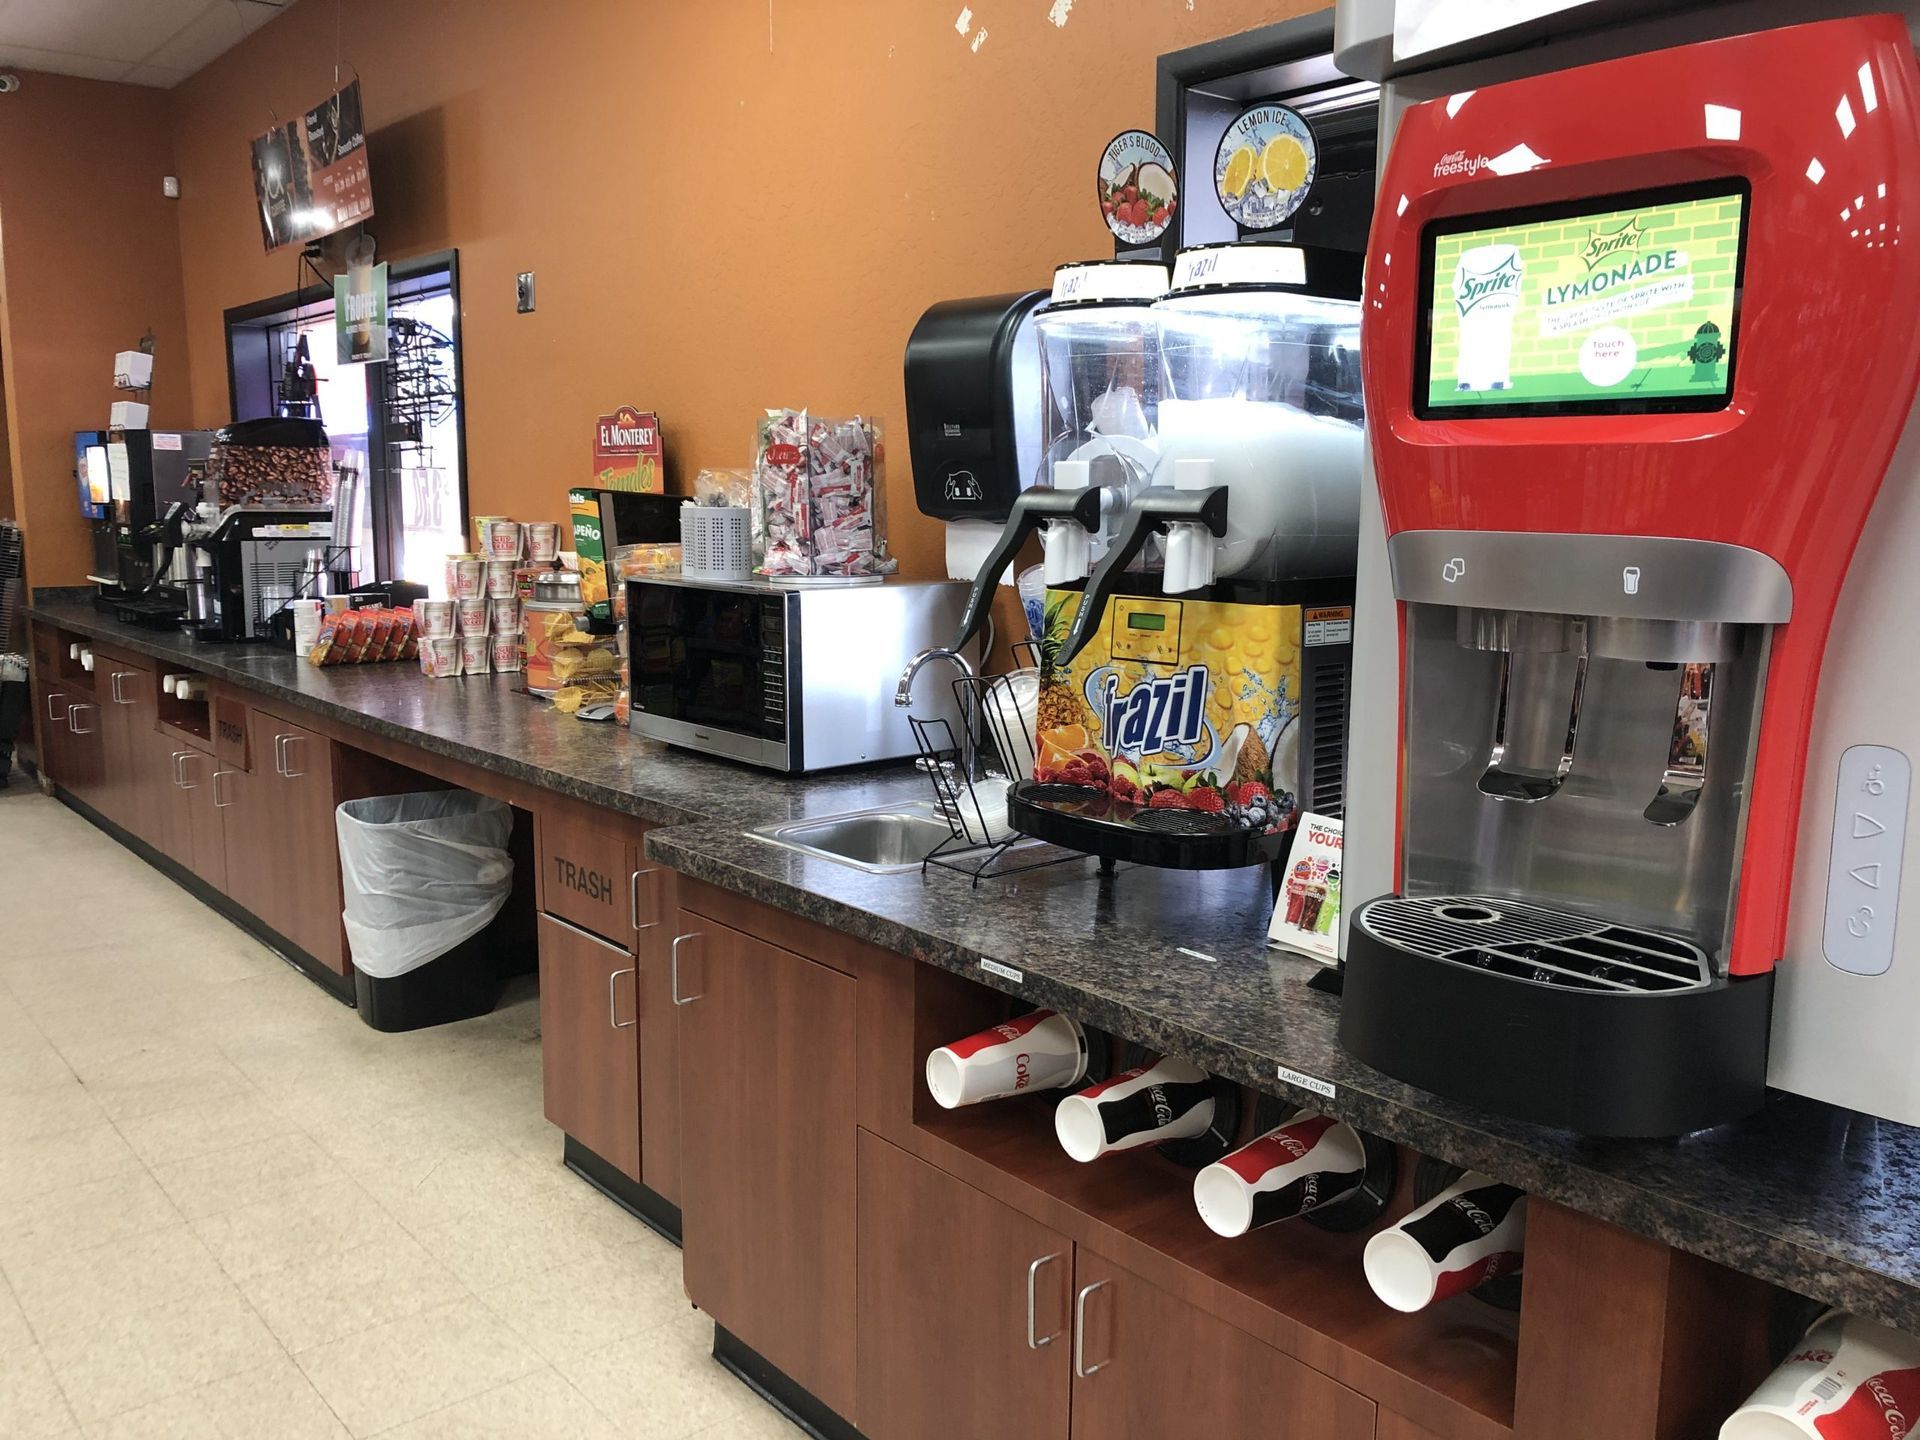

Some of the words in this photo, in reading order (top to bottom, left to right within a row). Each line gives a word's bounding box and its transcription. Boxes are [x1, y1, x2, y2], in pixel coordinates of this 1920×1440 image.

[1237, 110, 1269, 135] LEMON
[1272, 110, 1288, 127] ICE
[1109, 135, 1134, 158] TIGER'S
[1136, 136, 1161, 158] BLOOD
[1433, 154, 1489, 178] freestyle
[1586, 232, 1637, 257] Sprite
[1460, 271, 1515, 300] Sprite
[1547, 250, 1677, 305] LYMONADE
[1593, 340, 1624, 350] Touch
[611, 424, 655, 446] MONTEREY
[1078, 594, 1090, 617] PUSH
[1319, 610, 1344, 618] WARNING
[1103, 667, 1206, 758] frazil
[218, 720, 242, 746] TRASH
[1310, 823, 1322, 831] THE
[554, 856, 613, 906] TRASH
[983, 961, 1005, 974] MEDIUM
[1006, 970, 1021, 981] CUPS
[1015, 1053, 1030, 1090] Coke
[1282, 1071, 1308, 1086] LARGE
[1309, 1080, 1331, 1094] CUPS
